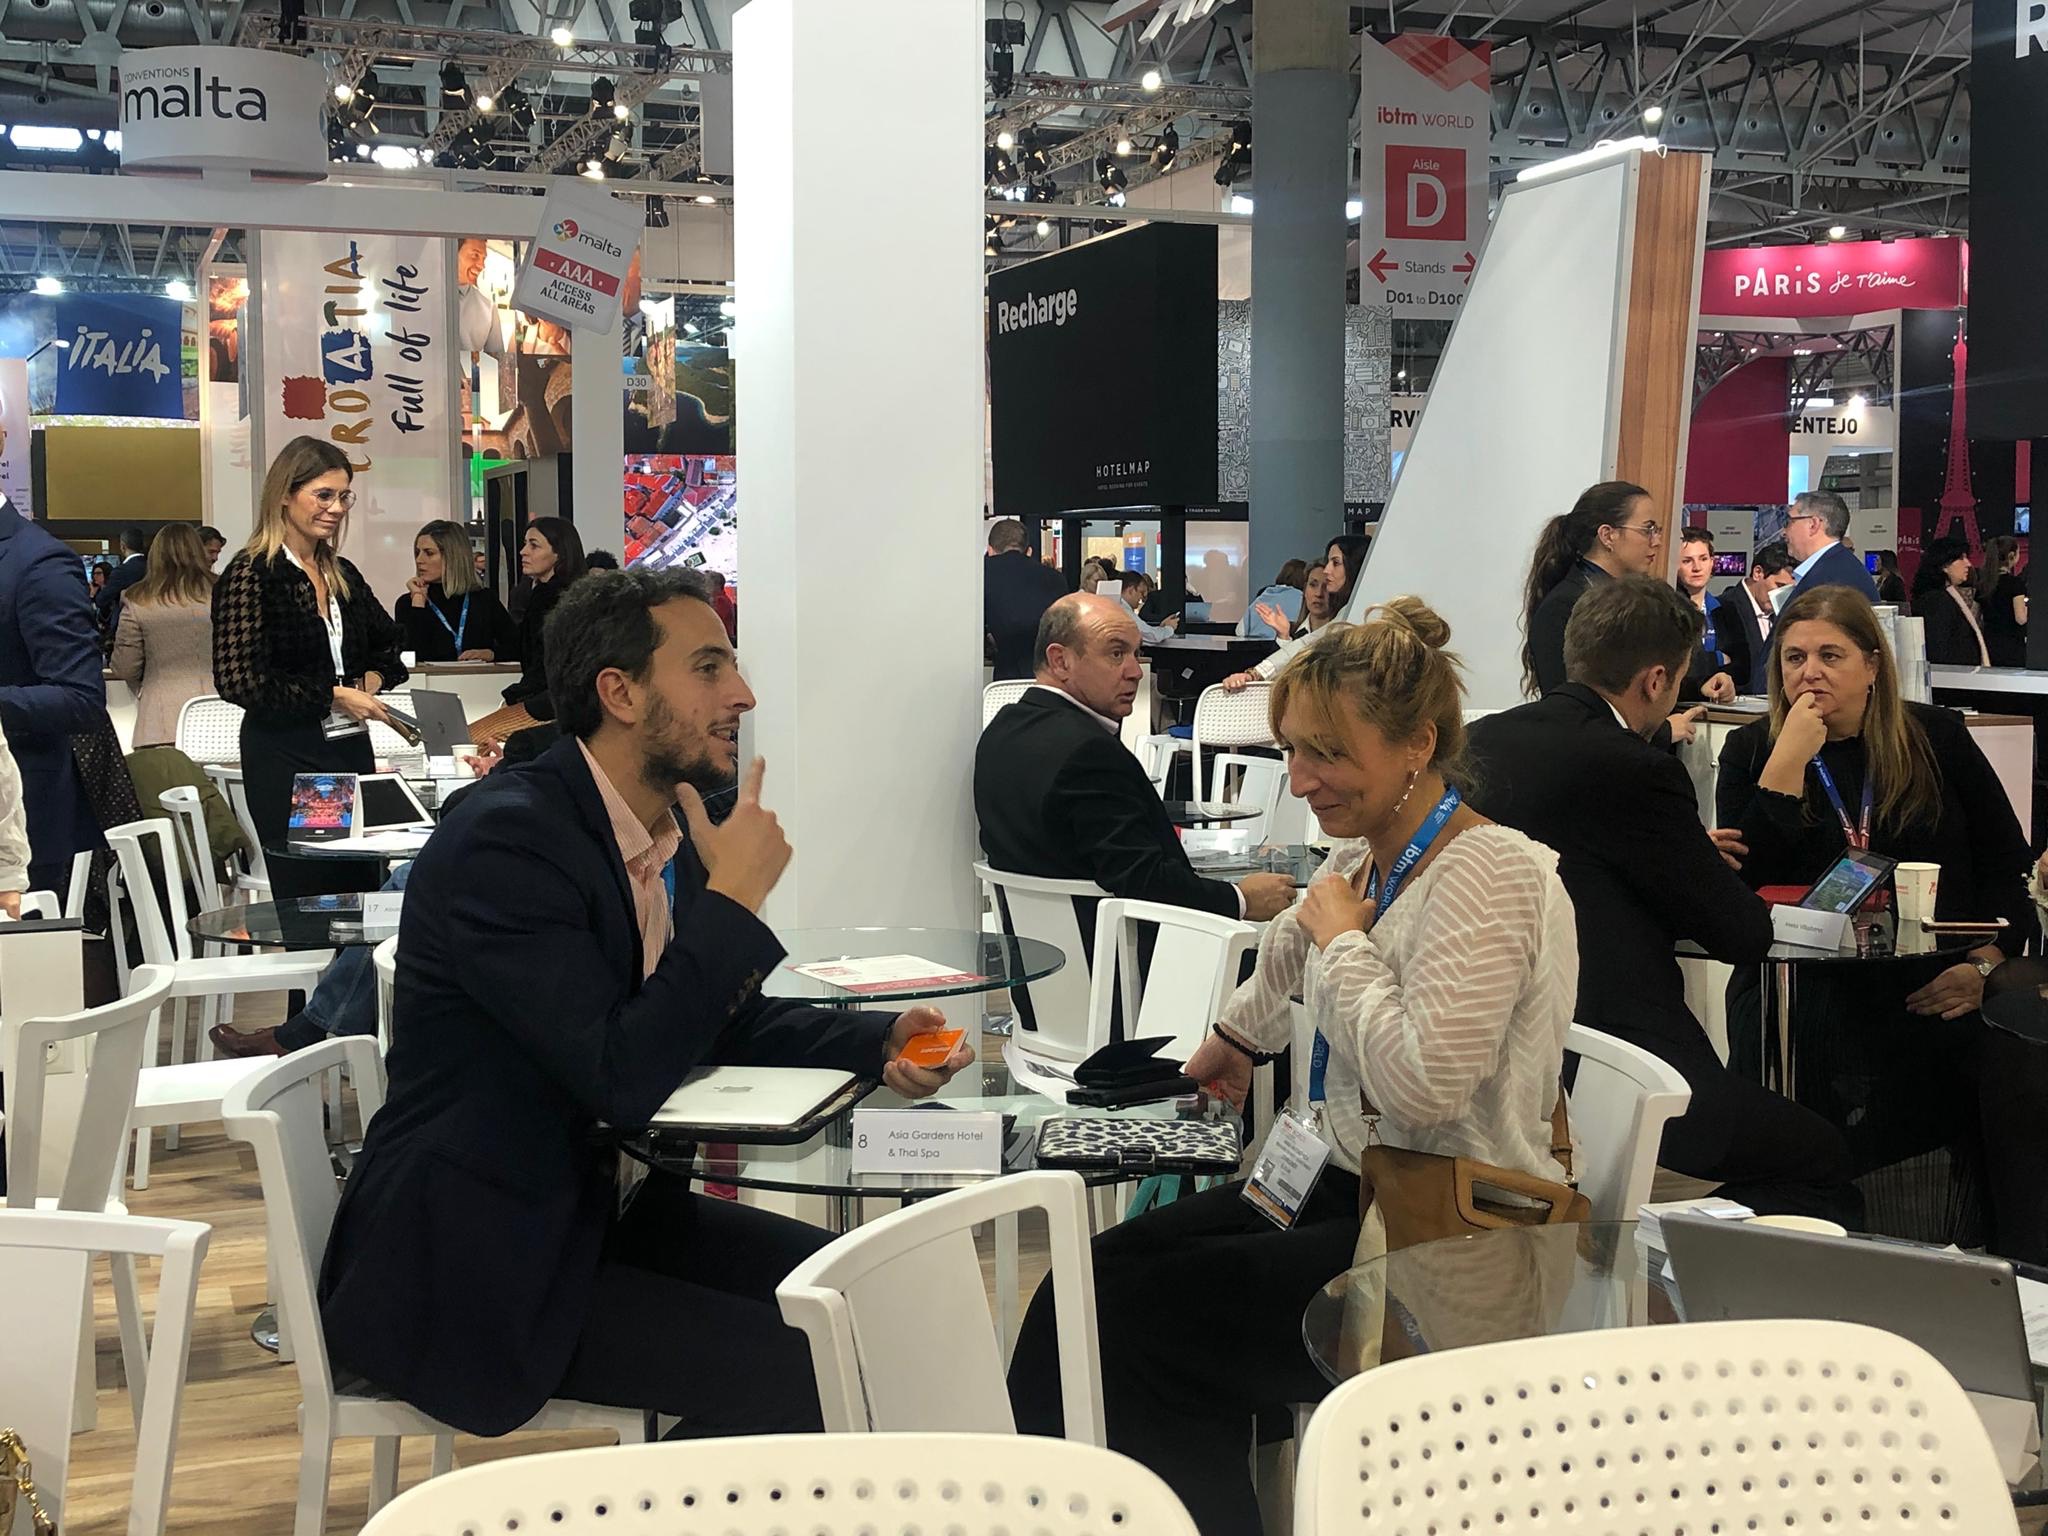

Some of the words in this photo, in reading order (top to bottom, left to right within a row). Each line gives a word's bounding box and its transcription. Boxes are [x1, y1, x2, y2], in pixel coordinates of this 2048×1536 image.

[124, 67, 190, 83] CONVENTIONS
[124, 66, 267, 124] malta
[1377, 106, 1418, 126] ibtm
[1422, 113, 1474, 129] WORLD
[1412, 158, 1441, 171] Aisle
[1406, 172, 1447, 227] D
[578, 232, 623, 258] malta
[558, 260, 593, 287] AAA
[1405, 260, 1446, 274] Stands
[382, 264, 429, 312] life
[550, 279, 592, 302] ACCESS
[1828, 270, 1852, 294] je
[540, 287, 559, 301] ALL
[560, 297, 596, 315] AREAS
[1386, 289, 1414, 305] D01
[1416, 295, 1426, 305] to
[998, 288, 1077, 335] Recharge
[385, 326, 431, 363] of
[626, 377, 647, 387] D30
[390, 373, 425, 434] Full
[1096, 460, 1150, 478] HOTELMAP
[1347, 507, 1372, 515] MAP
[1394, 843, 1423, 873] ibtm
[857, 1134, 868, 1149] 8
[888, 1130, 909, 1140] Asia
[911, 1130, 955, 1141] Gardens
[957, 1131, 983, 1141] Hotel
[888, 1148, 896, 1158] &
[898, 1148, 918, 1158] Thai
[921, 1149, 940, 1159] Spa
